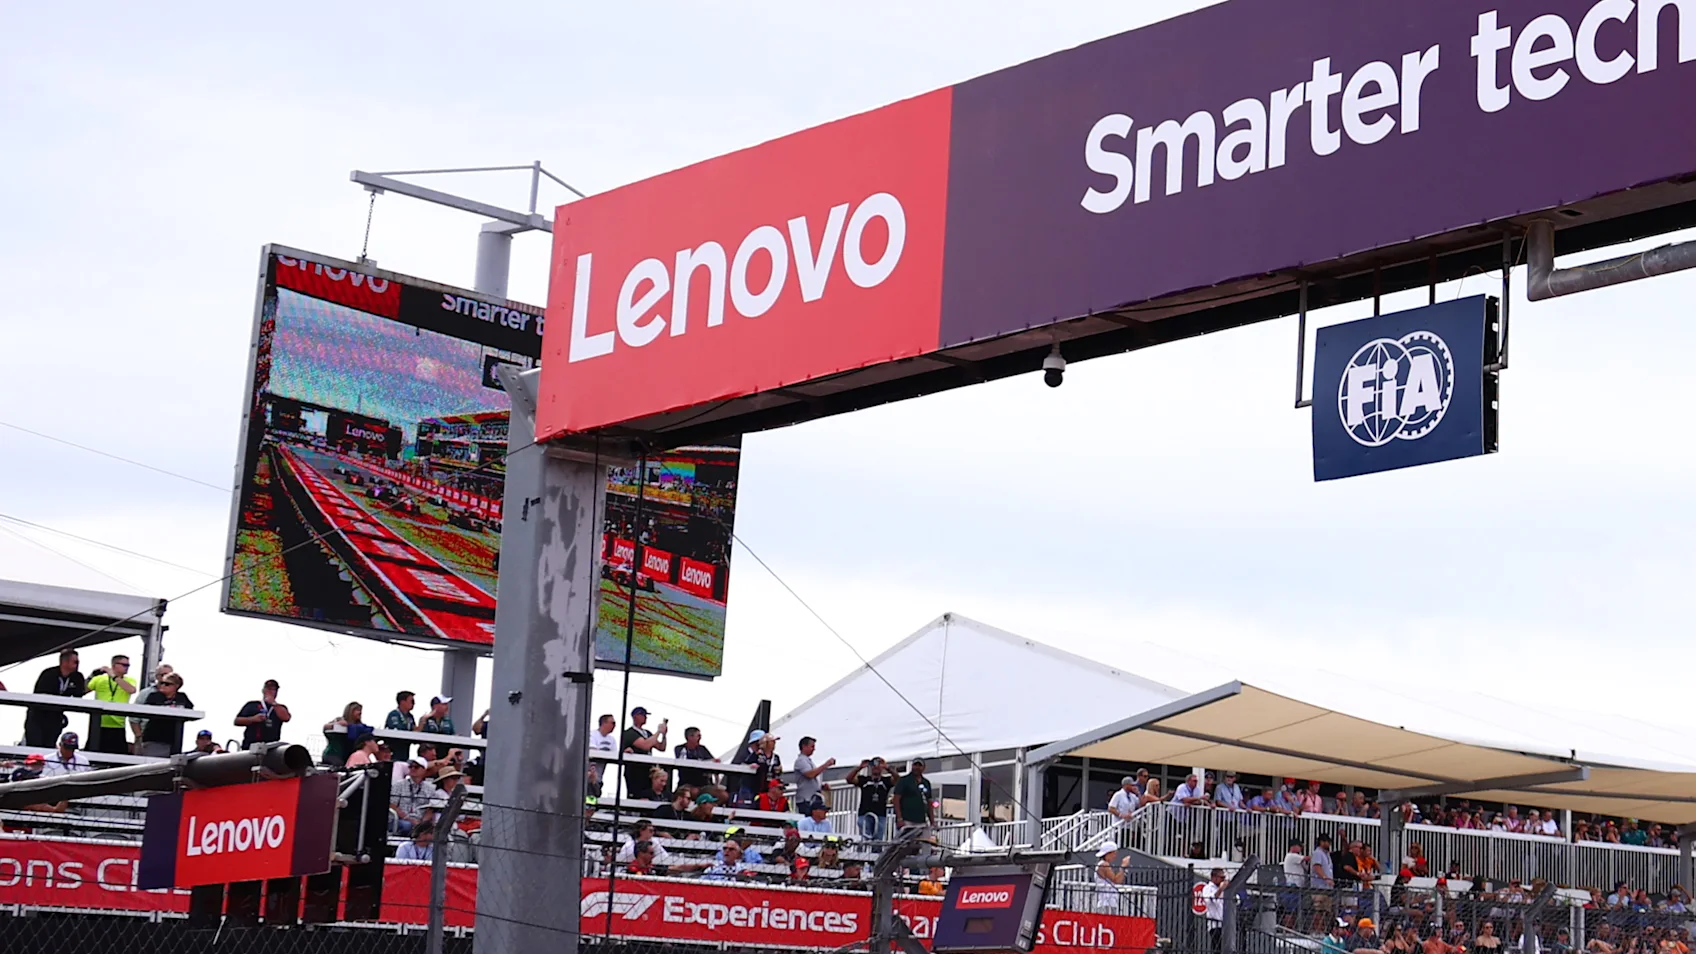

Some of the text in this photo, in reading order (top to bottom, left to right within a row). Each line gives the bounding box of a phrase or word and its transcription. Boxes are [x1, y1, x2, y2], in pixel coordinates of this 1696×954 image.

[1080, 43, 1441, 214] Smarter
[568, 192, 907, 363] Lenovo
[345, 424, 385, 442] Lenovo
[644, 549, 669, 575] Lenovo
[681, 561, 712, 588] Lenovo
[187, 814, 286, 857] Lenovo
[961, 891, 1009, 904] Lenovo
[663, 895, 858, 934] Experiences
[1053, 920, 1115, 949] Club
